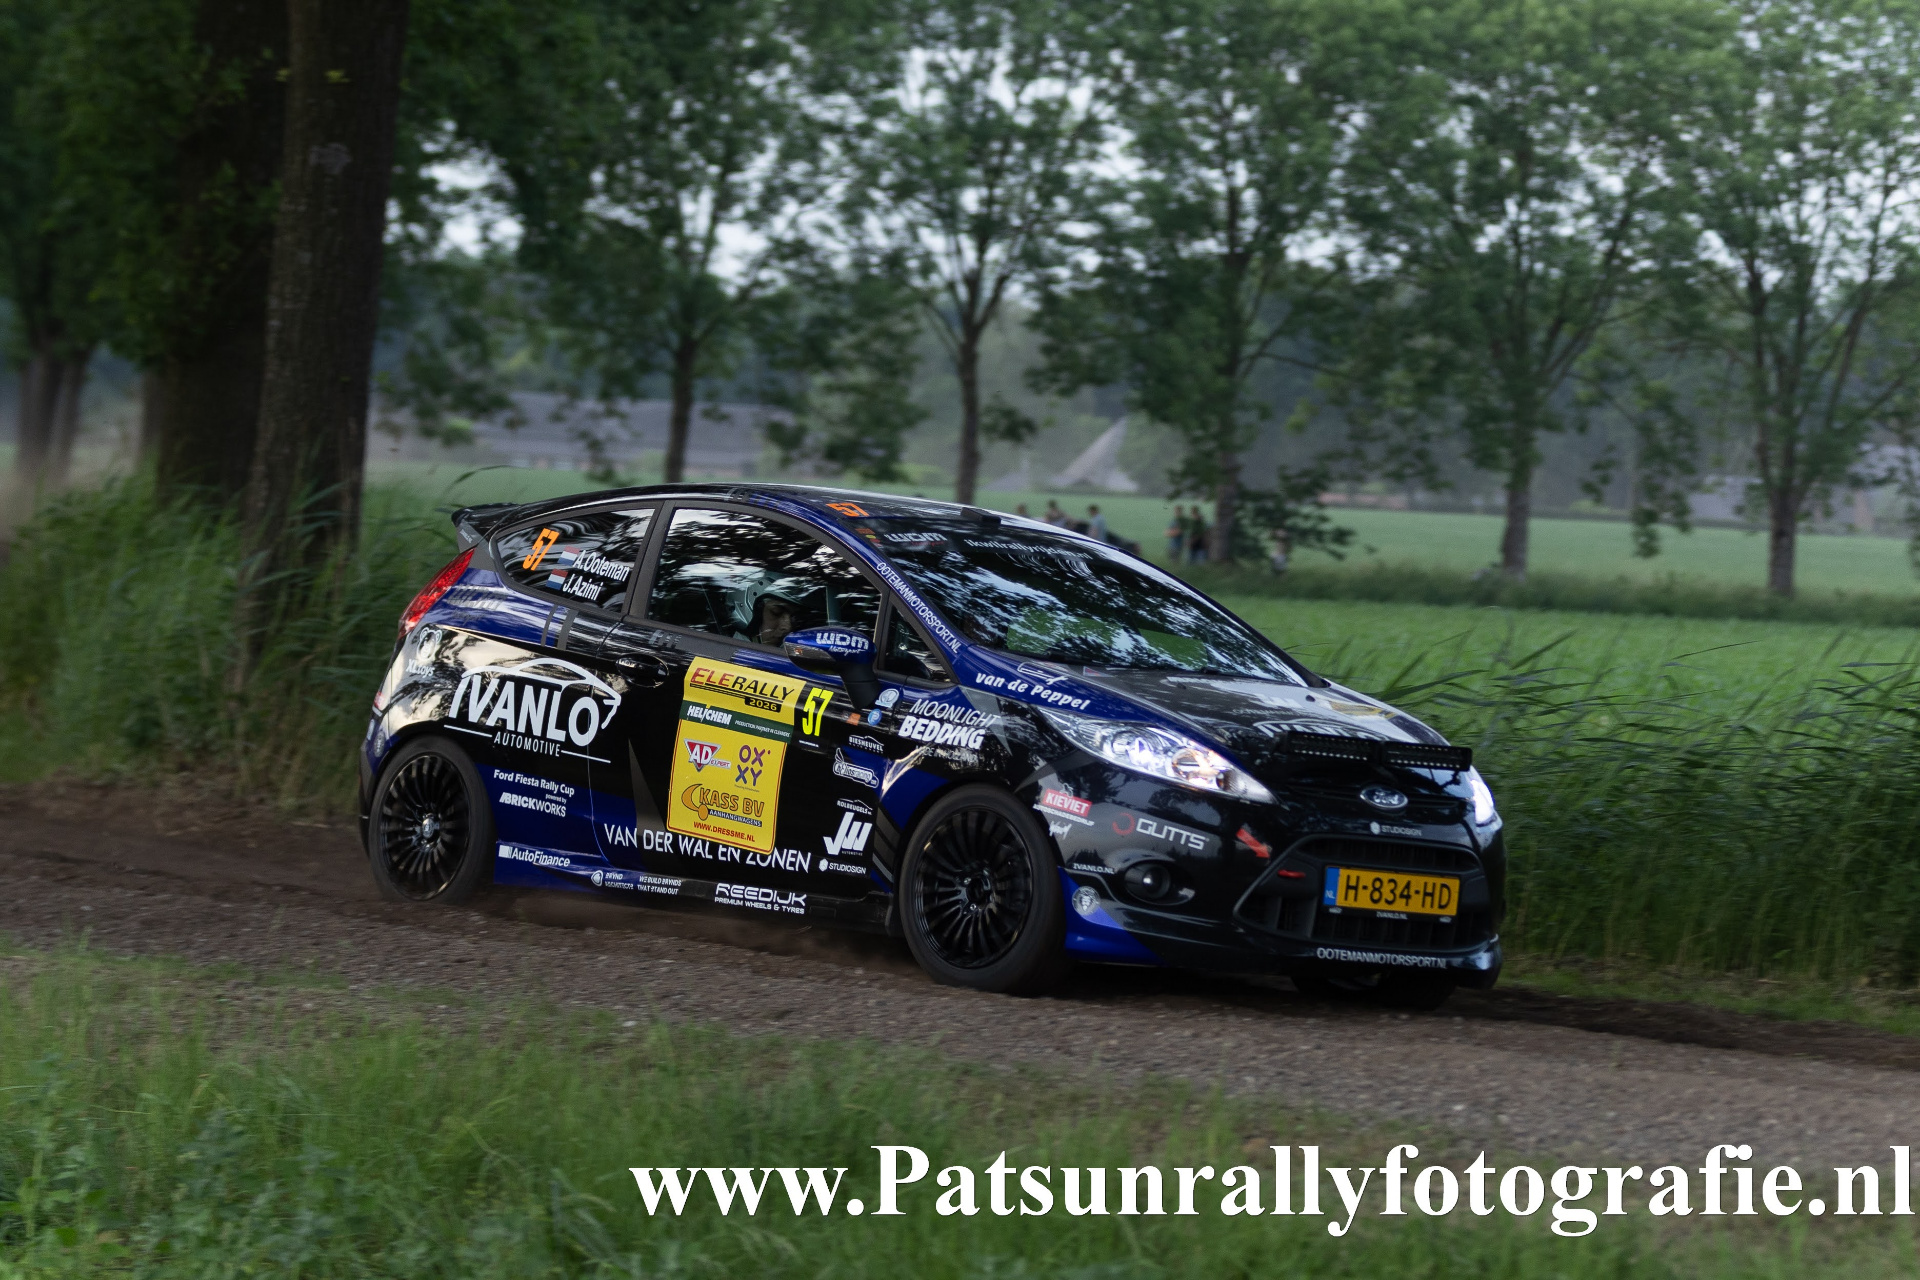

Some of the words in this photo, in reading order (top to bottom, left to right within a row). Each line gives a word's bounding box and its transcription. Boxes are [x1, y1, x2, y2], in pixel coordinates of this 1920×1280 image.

[826, 502, 870, 517] 57
[522, 528, 560, 571] 57
[572, 550, 630, 582] A.Ooteman
[562, 574, 603, 601] J.Azimi
[876, 561, 962, 654] OOTEMANMOTORSPORT.NL
[690, 667, 795, 700] ELERALLY
[975, 673, 1003, 688] van
[1007, 679, 1027, 693] de
[1031, 685, 1091, 710] Peppel
[449, 674, 600, 746] IVANLO
[749, 698, 777, 711] 2026
[802, 687, 834, 736] 57
[909, 698, 1001, 728] MOONLIGHT
[494, 732, 561, 757] AUTOMOTIVE
[898, 715, 985, 750] BEDDING
[690, 744, 713, 764] AD
[493, 769, 514, 782] Ford
[515, 774, 539, 787] Fiesta
[540, 779, 559, 794] Rally
[560, 784, 575, 797] Cup
[735, 764, 762, 787] XY
[500, 792, 567, 817] BRICKWORKS
[545, 793, 562, 802] powered
[699, 787, 739, 811] KASS
[742, 798, 765, 817] BV
[1045, 792, 1089, 815] KIEVIET
[1373, 790, 1399, 804] Ford
[709, 809, 761, 827] AANHANGWAGENS
[604, 823, 638, 848] VAN
[643, 829, 674, 854] DER
[678, 834, 713, 860] WAL
[718, 844, 740, 863] EN
[693, 821, 755, 842] WWW.DRESSME.NL
[1136, 817, 1206, 850] GUTTS
[511, 847, 571, 867] AutoFinance
[828, 862, 867, 875] STUDIOSIGN
[1072, 862, 1116, 875] IVANLO.NL
[715, 883, 808, 907] REEDIJK
[1325, 889, 1335, 899] NL
[1344, 874, 1452, 910] H-834-HD
[714, 896, 744, 907] PREMIUM
[744, 900, 772, 911] WHEELS
[781, 905, 805, 915] TYRES
[1317, 947, 1448, 969] OOTEMANMOTORSPORT.NL
